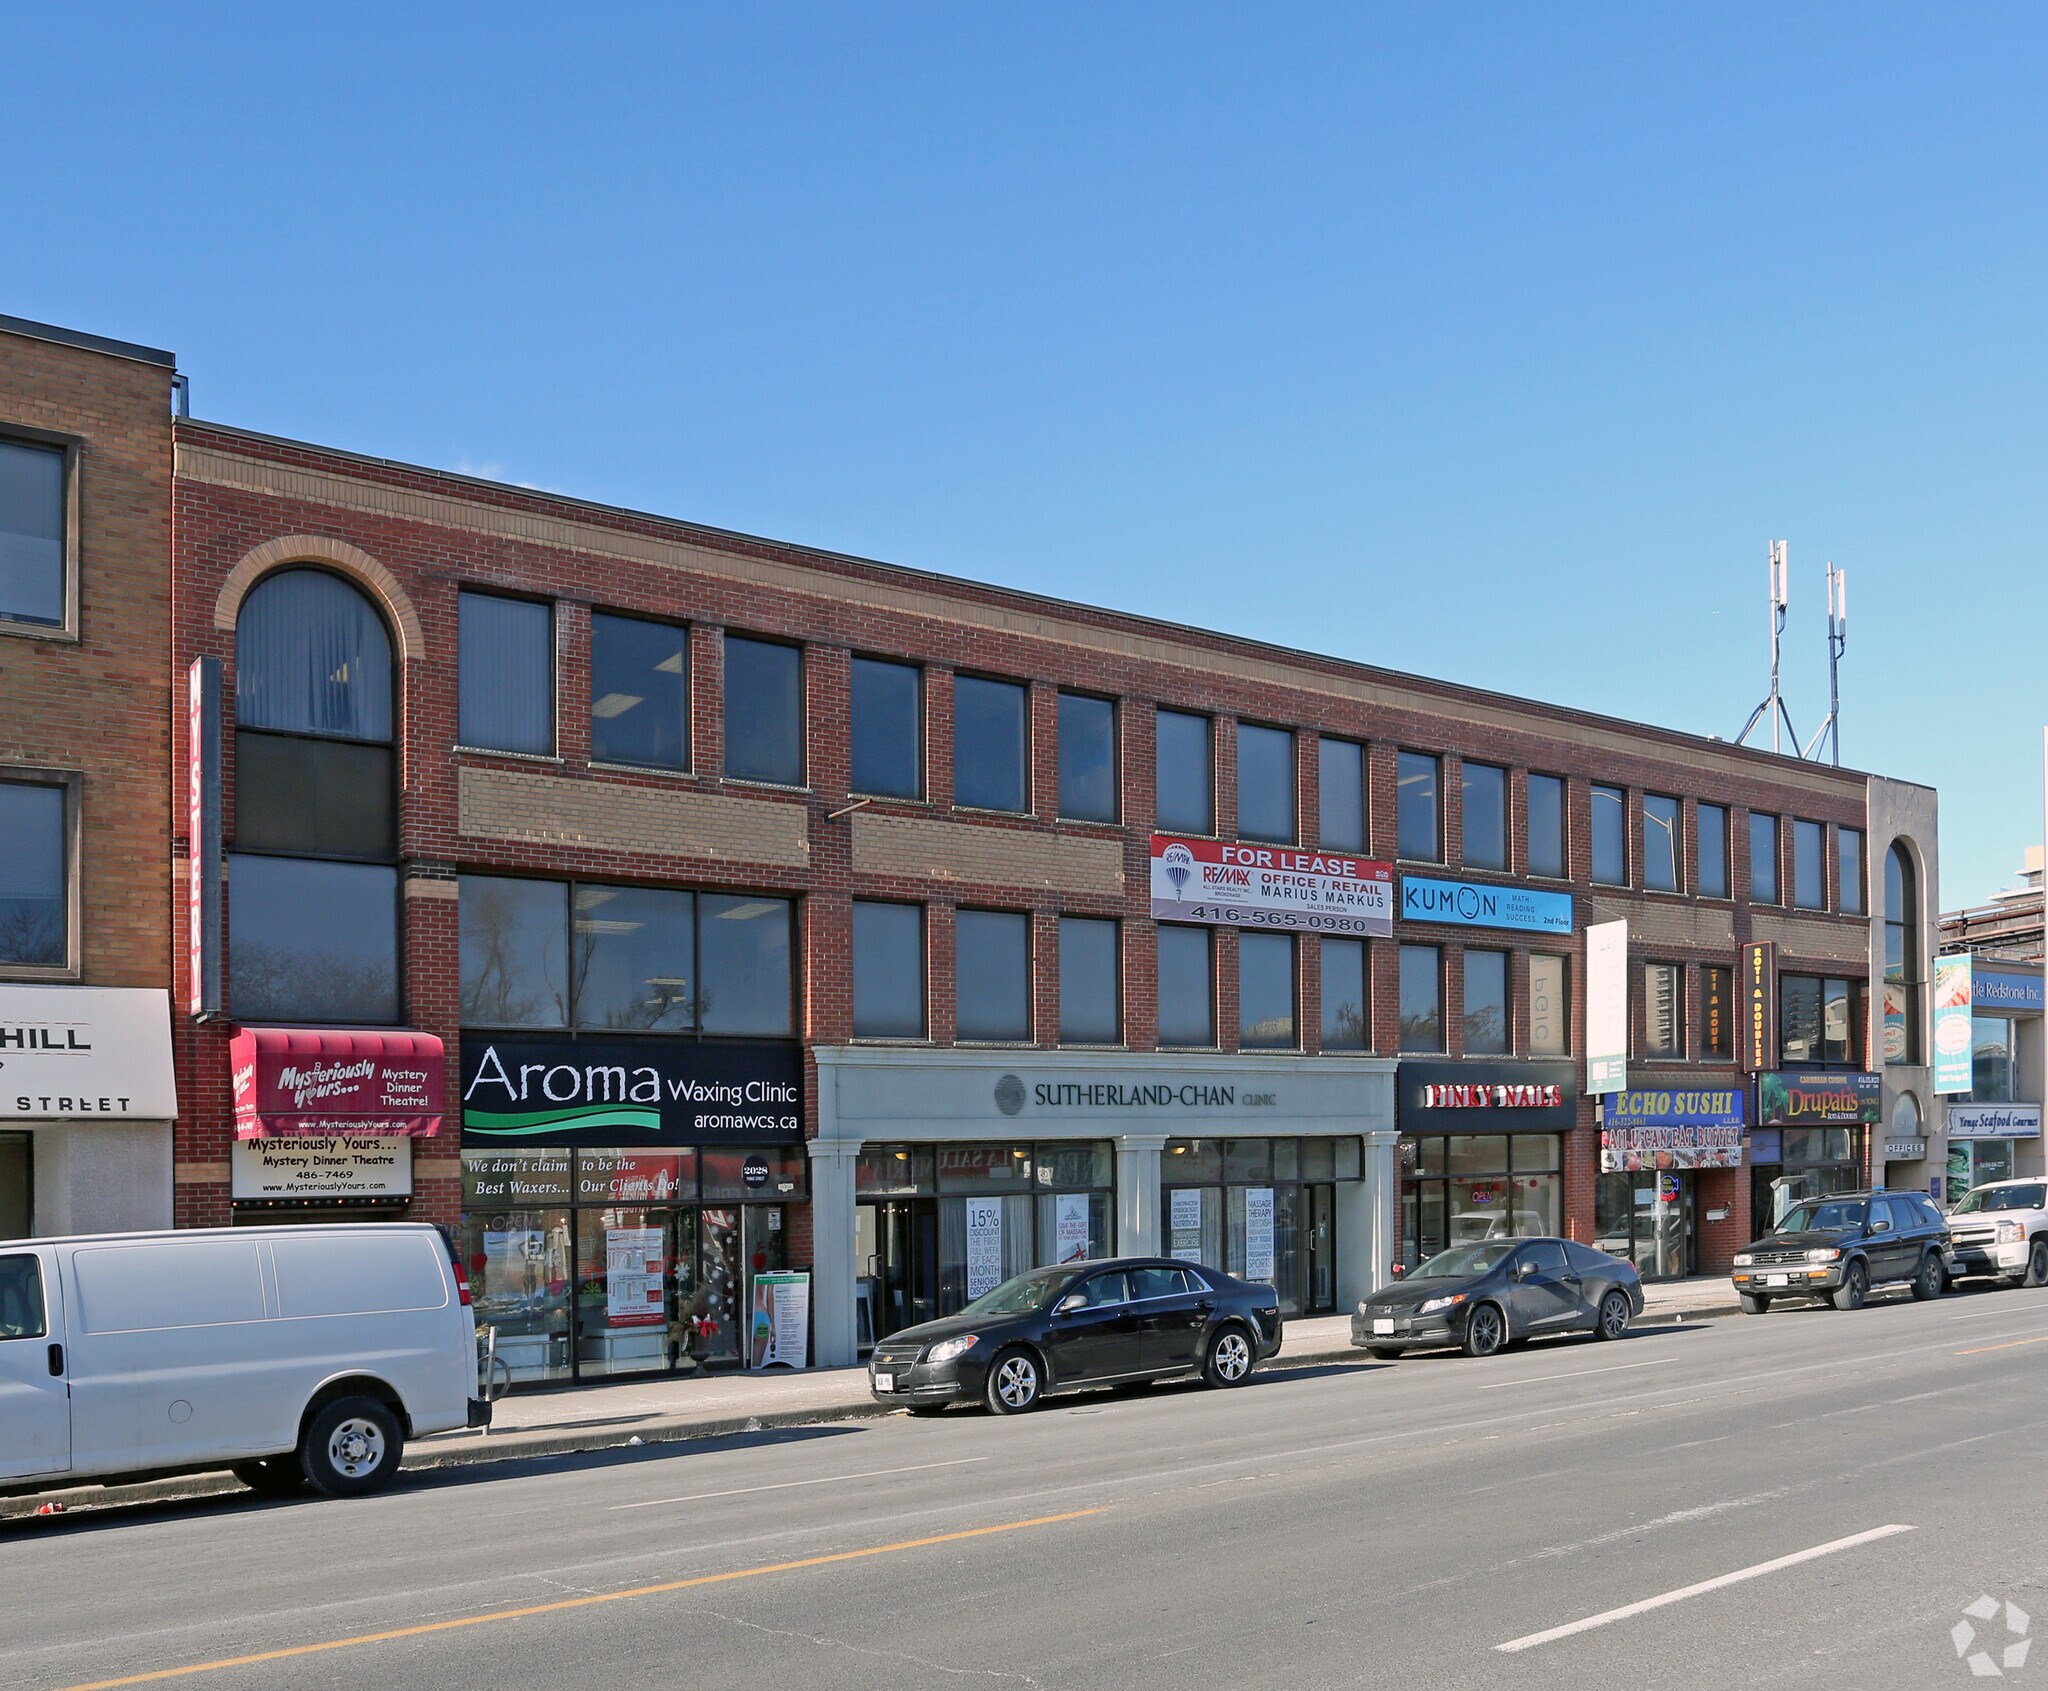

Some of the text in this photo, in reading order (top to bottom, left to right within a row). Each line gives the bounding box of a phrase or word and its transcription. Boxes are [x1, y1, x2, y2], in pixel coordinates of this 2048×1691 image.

[190, 664, 201, 997] MYSTERY
[1222, 846, 1356, 878] FOR LEASE
[1203, 866, 1251, 886] RE/MAX
[1261, 873, 1316, 888] OFFICE
[1332, 881, 1382, 896] RETAIL
[1261, 885, 1384, 908] MARIUS MARKUS
[1405, 886, 1497, 920] KUMON
[1306, 903, 1324, 911] SALES
[1190, 905, 1367, 932] 416-565-0980
[1543, 916, 1569, 926] 2nd Floor
[1753, 947, 1762, 985] ROTI
[1753, 988, 1762, 998] &
[1971, 980, 2042, 1001] tle Redstone Inc.
[1753, 1002, 1762, 1067] DOUBLES
[278, 1059, 375, 1090] Mysteriously
[382, 1068, 428, 1082] Mystery
[464, 1045, 661, 1102] Aroma
[386, 1082, 422, 1093] Dinner
[667, 1079, 797, 1106] Waxing Clinic
[1035, 1083, 1276, 1106] SUTHERLAND-CHAN CLINIC
[380, 1095, 428, 1106] Theatre!
[1425, 1084, 1562, 1108] PINKY NAILS
[1615, 1092, 1733, 1116] ECHO SUSHI
[298, 1119, 407, 1130] www.MysteriouslyYours.com
[694, 1113, 797, 1130] aromawcs.ca
[1960, 1111, 2039, 1134] Yonge Seafood Gourmet
[1644, 1128, 1668, 1148] CAN
[1671, 1127, 1694, 1148] EAT
[1697, 1127, 1739, 1147] BUFFET
[248, 1137, 397, 1154] Mysteriously Yours...
[1888, 1144, 1922, 1152] OFFICES
[263, 1155, 394, 1168] Mystery Dinner Theatre
[468, 1158, 636, 1172] We don't claim to be the
[296, 1170, 353, 1179] 486-7469
[743, 1166, 768, 1175] 2028
[262, 1181, 386, 1192] www.MysteriouslyYours.com
[475, 1181, 504, 1195] Best
[509, 1180, 570, 1194] Waxers...
[580, 1179, 606, 1193] Our
[609, 1178, 653, 1193] Clients
[658, 1177, 680, 1192] Do!
[1248, 1199, 1272, 1208] MASSAGE
[970, 1209, 999, 1228] 15%
[1248, 1208, 1272, 1218] THERAPY
[1248, 1218, 1272, 1228] SWEDISH
[969, 1228, 1000, 1237] DISCOUNT
[970, 1237, 1000, 1246] THE FIRST
[1173, 1238, 1199, 1248] EXERCISE
[970, 1246, 999, 1255] FULL WEEK
[969, 1255, 1000, 1265] OF EACH
[1248, 1258, 1272, 1269] SPORTS
[969, 1265, 1000, 1277] MONTH
